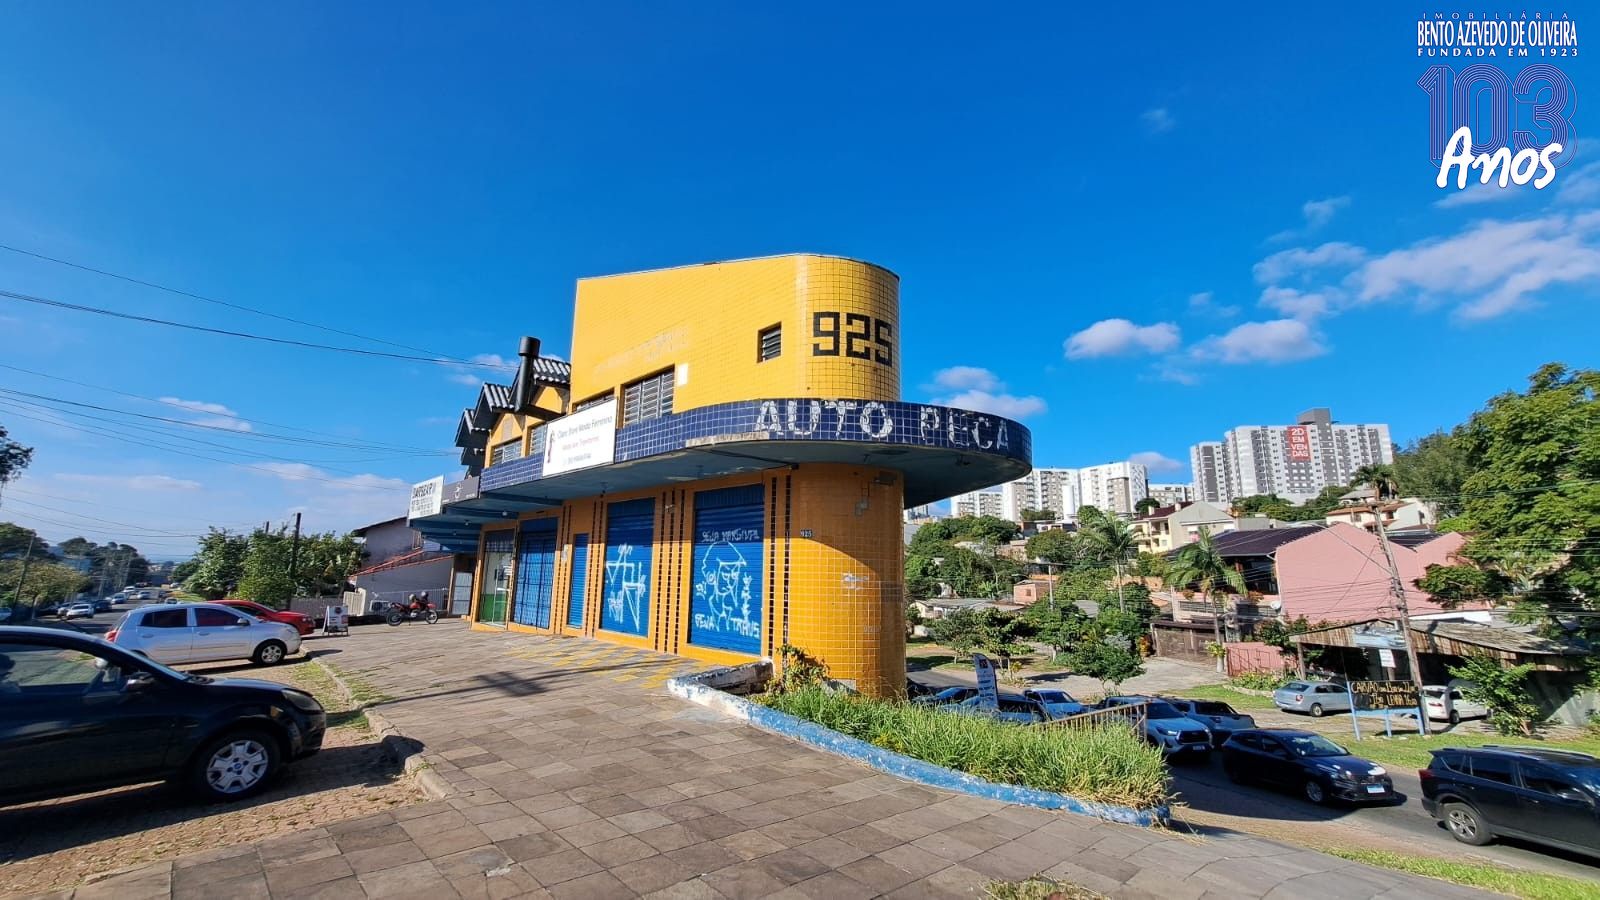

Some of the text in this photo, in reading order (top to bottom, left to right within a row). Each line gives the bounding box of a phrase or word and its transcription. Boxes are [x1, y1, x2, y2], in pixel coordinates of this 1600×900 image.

[812, 310, 893, 367] 925
[754, 400, 893, 438] AUTO
[800, 529, 812, 538] 925
